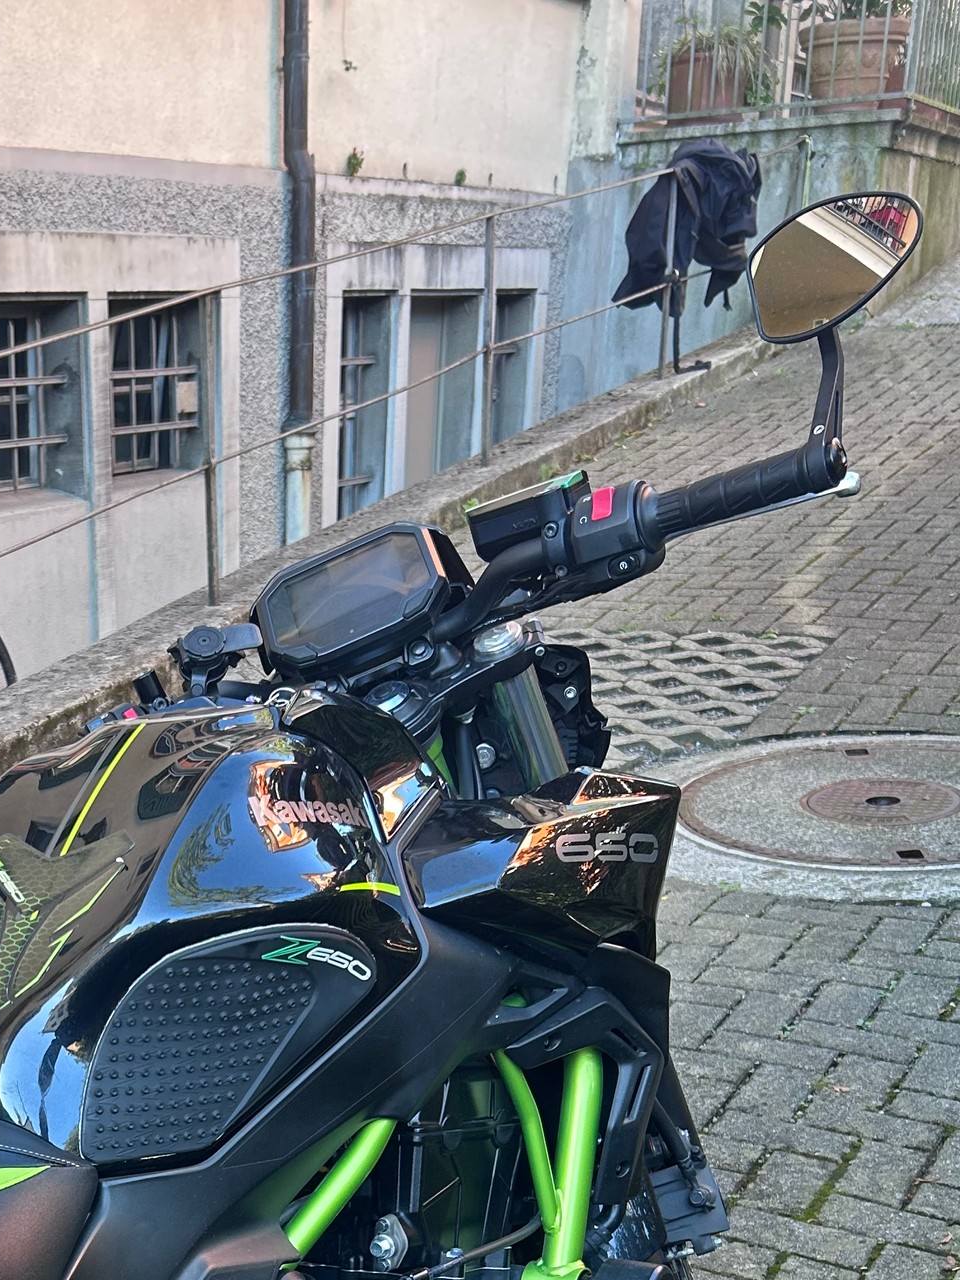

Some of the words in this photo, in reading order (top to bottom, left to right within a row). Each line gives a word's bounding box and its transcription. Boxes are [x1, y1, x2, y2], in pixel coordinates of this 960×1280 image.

[248, 794, 371, 828] Kawasaki
[555, 832, 659, 863] 650
[261, 935, 372, 981] Z650
